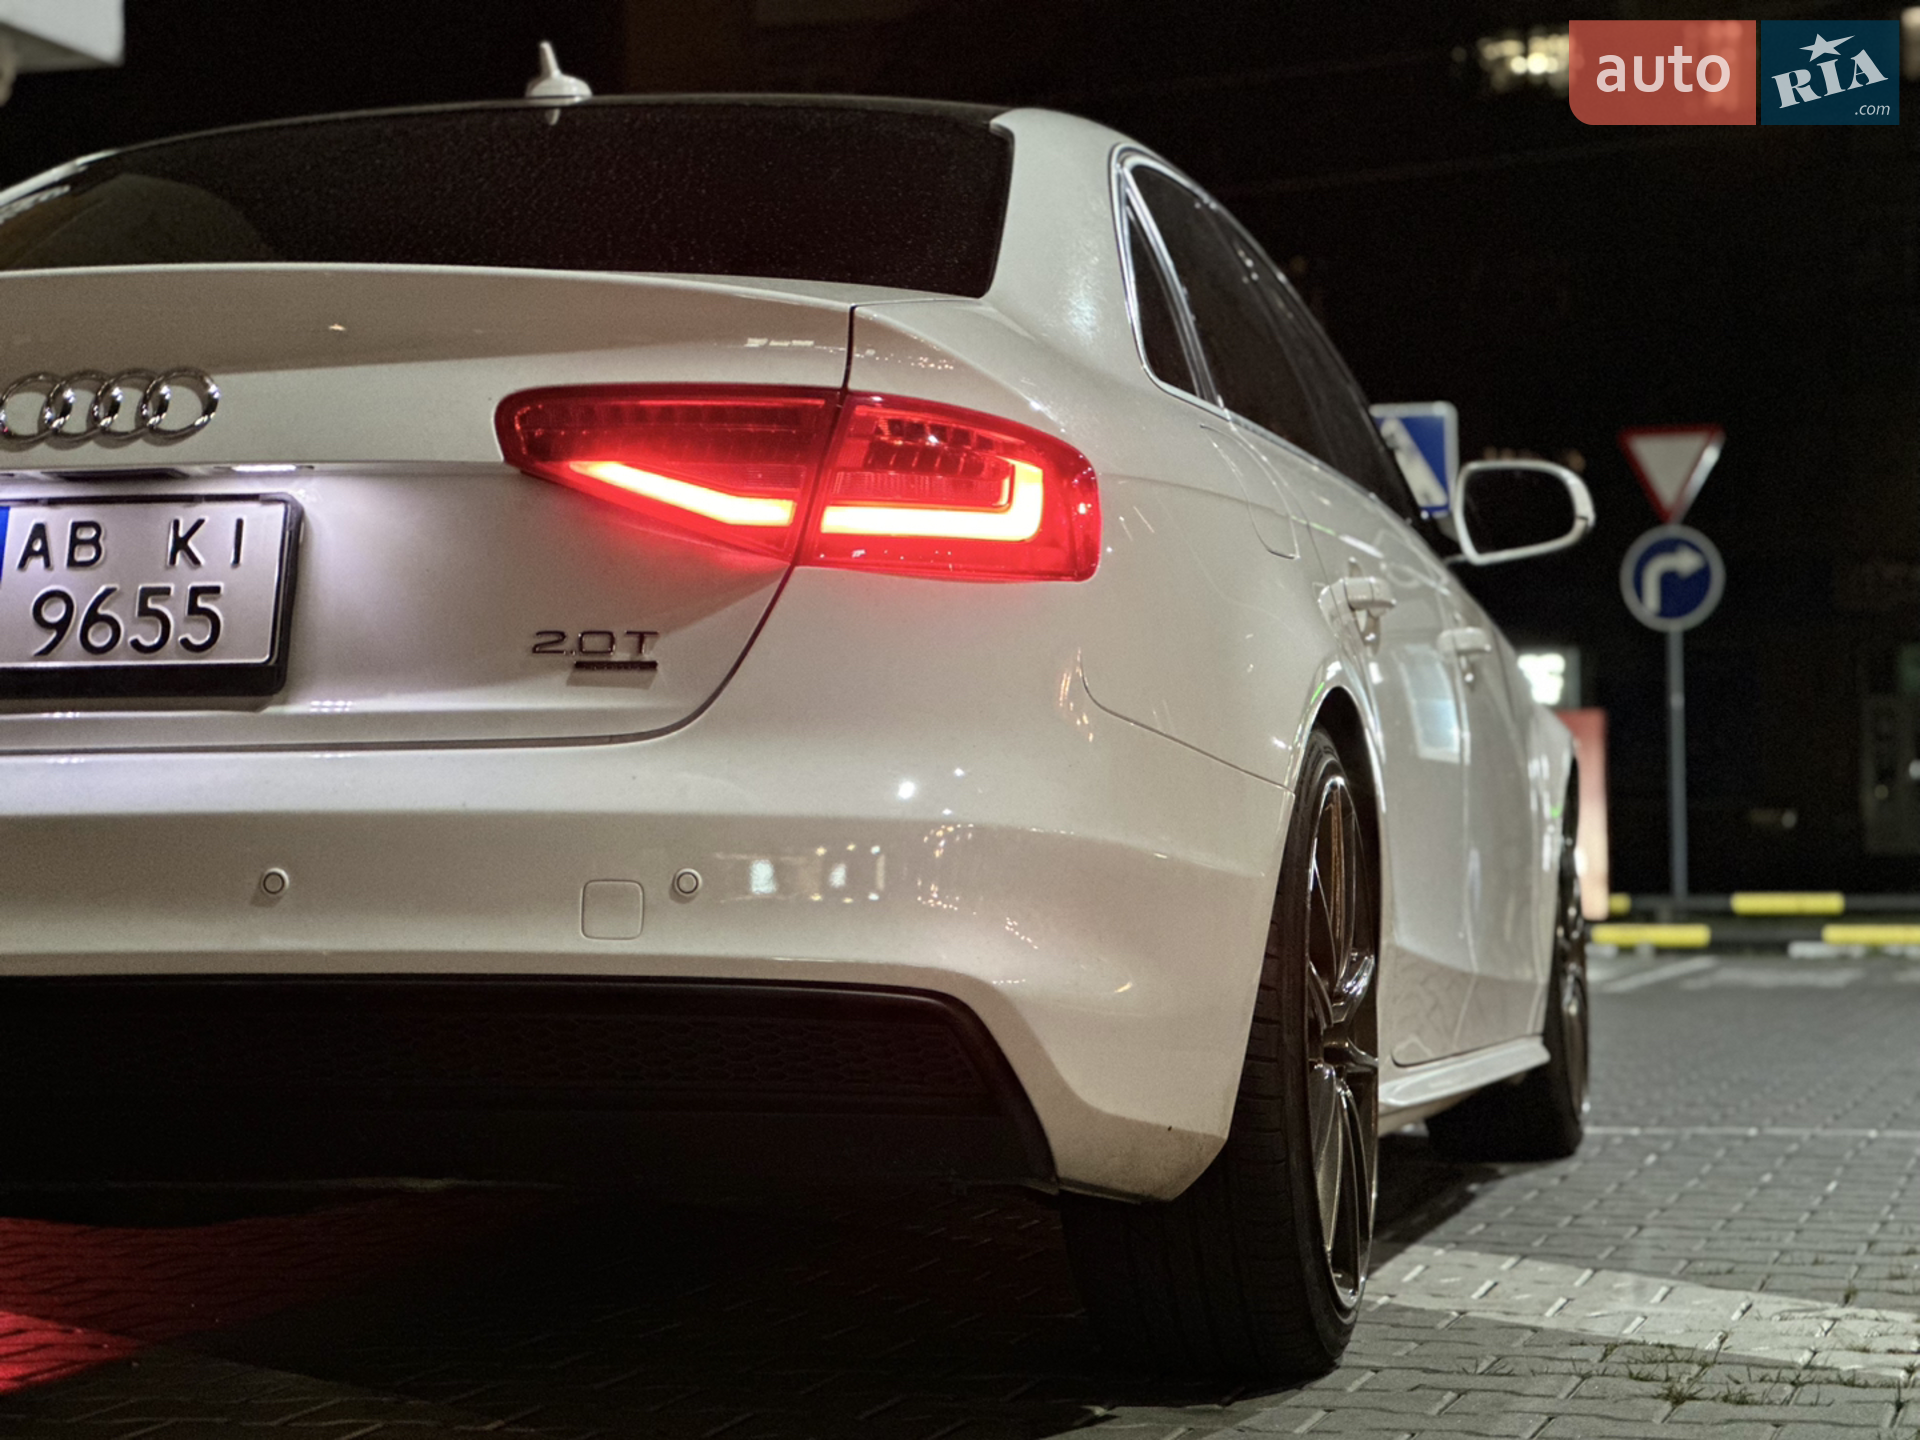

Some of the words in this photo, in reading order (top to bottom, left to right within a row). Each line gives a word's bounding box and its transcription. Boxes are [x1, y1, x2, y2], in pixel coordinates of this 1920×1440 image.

[17, 519, 105, 571] AB
[167, 517, 245, 568] KI
[31, 584, 224, 657] 9655
